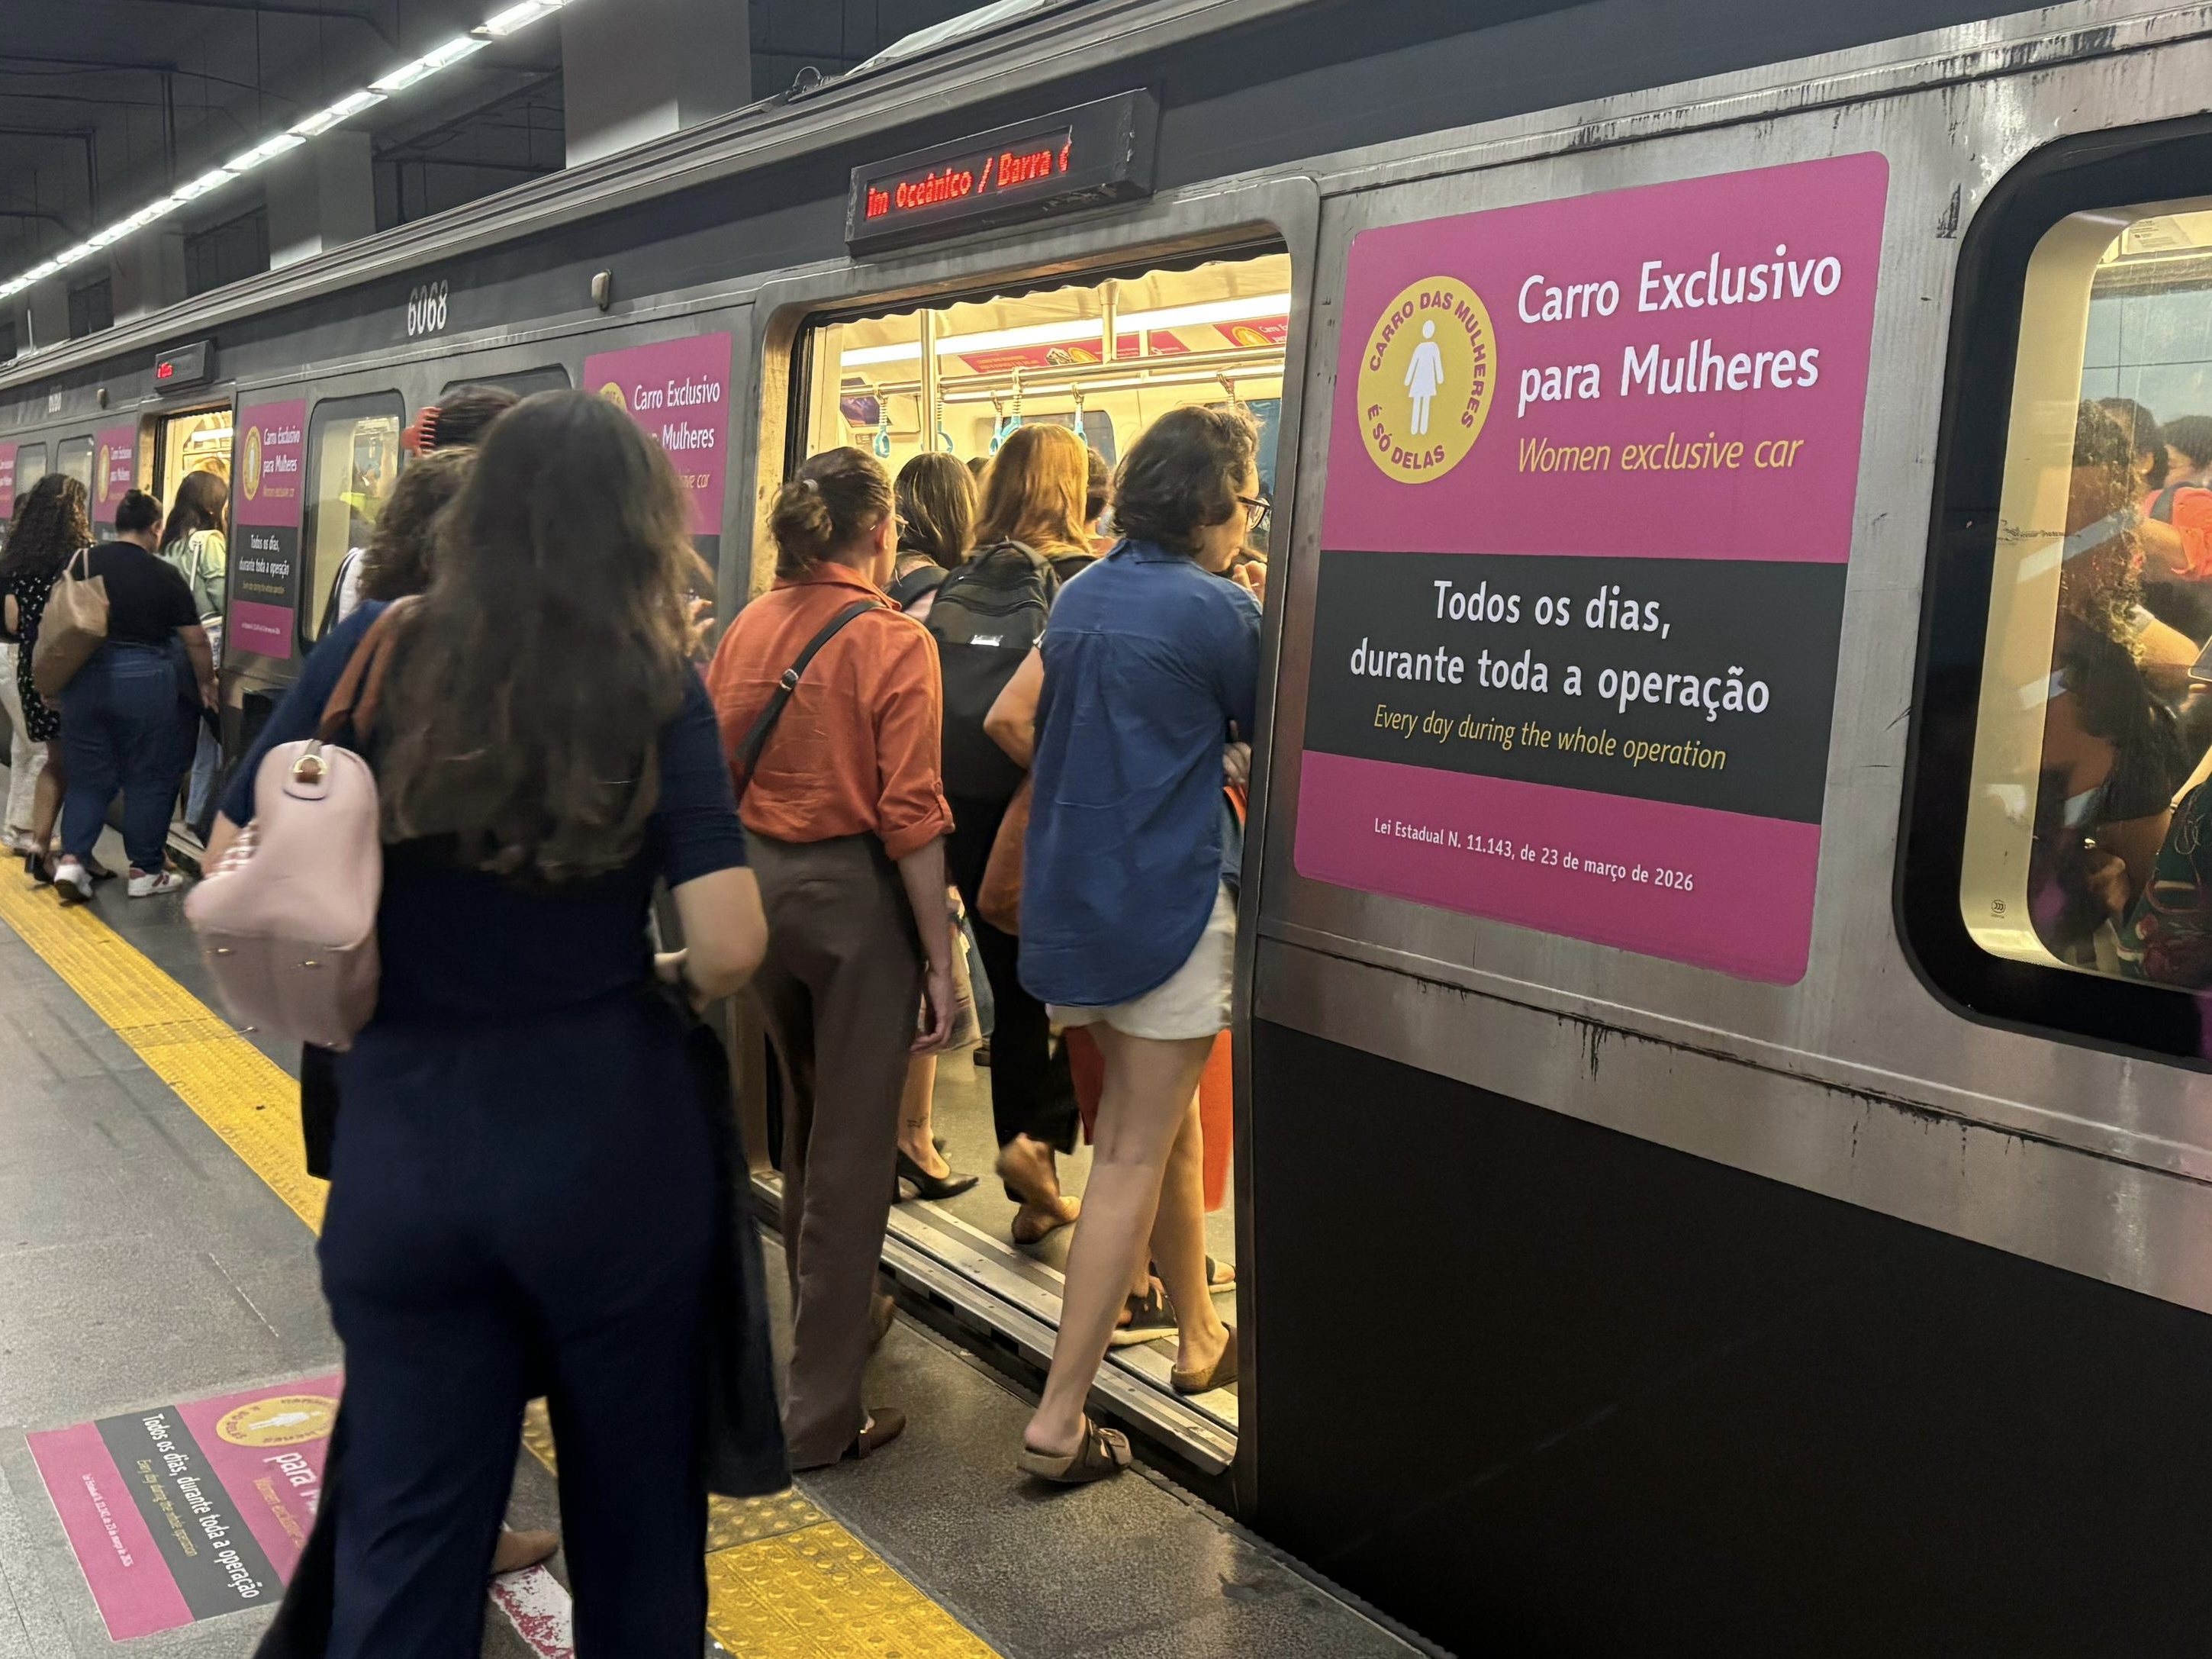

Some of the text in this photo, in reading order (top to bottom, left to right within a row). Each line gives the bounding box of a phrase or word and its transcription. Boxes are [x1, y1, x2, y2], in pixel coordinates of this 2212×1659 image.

[997, 150, 1051, 187] Barra
[407, 279, 449, 337] 6068
[1518, 243, 1841, 324] Carro Exclusivo
[1370, 290, 1487, 429] CARRO DAS MULHERES
[1518, 338, 1819, 419] para Mulheres
[634, 384, 663, 411] Carro
[667, 375, 721, 408] Exclusivo
[662, 420, 715, 451] Mulheres
[1367, 404, 1446, 470] É SÓ DELAS
[1519, 431, 1805, 472] Women exclusive car
[1434, 580, 1670, 639] Todos os dias,
[1351, 636, 1769, 722] durante toda a operação
[1373, 704, 1726, 770] Every day during the whole operation
[1374, 817, 1693, 891] Lei Estadual N. 11.143, de 23 de março de 2026
[262, 1451, 318, 1487] para
[142, 1413, 263, 1599] Todos os dias, durante toda a operação
